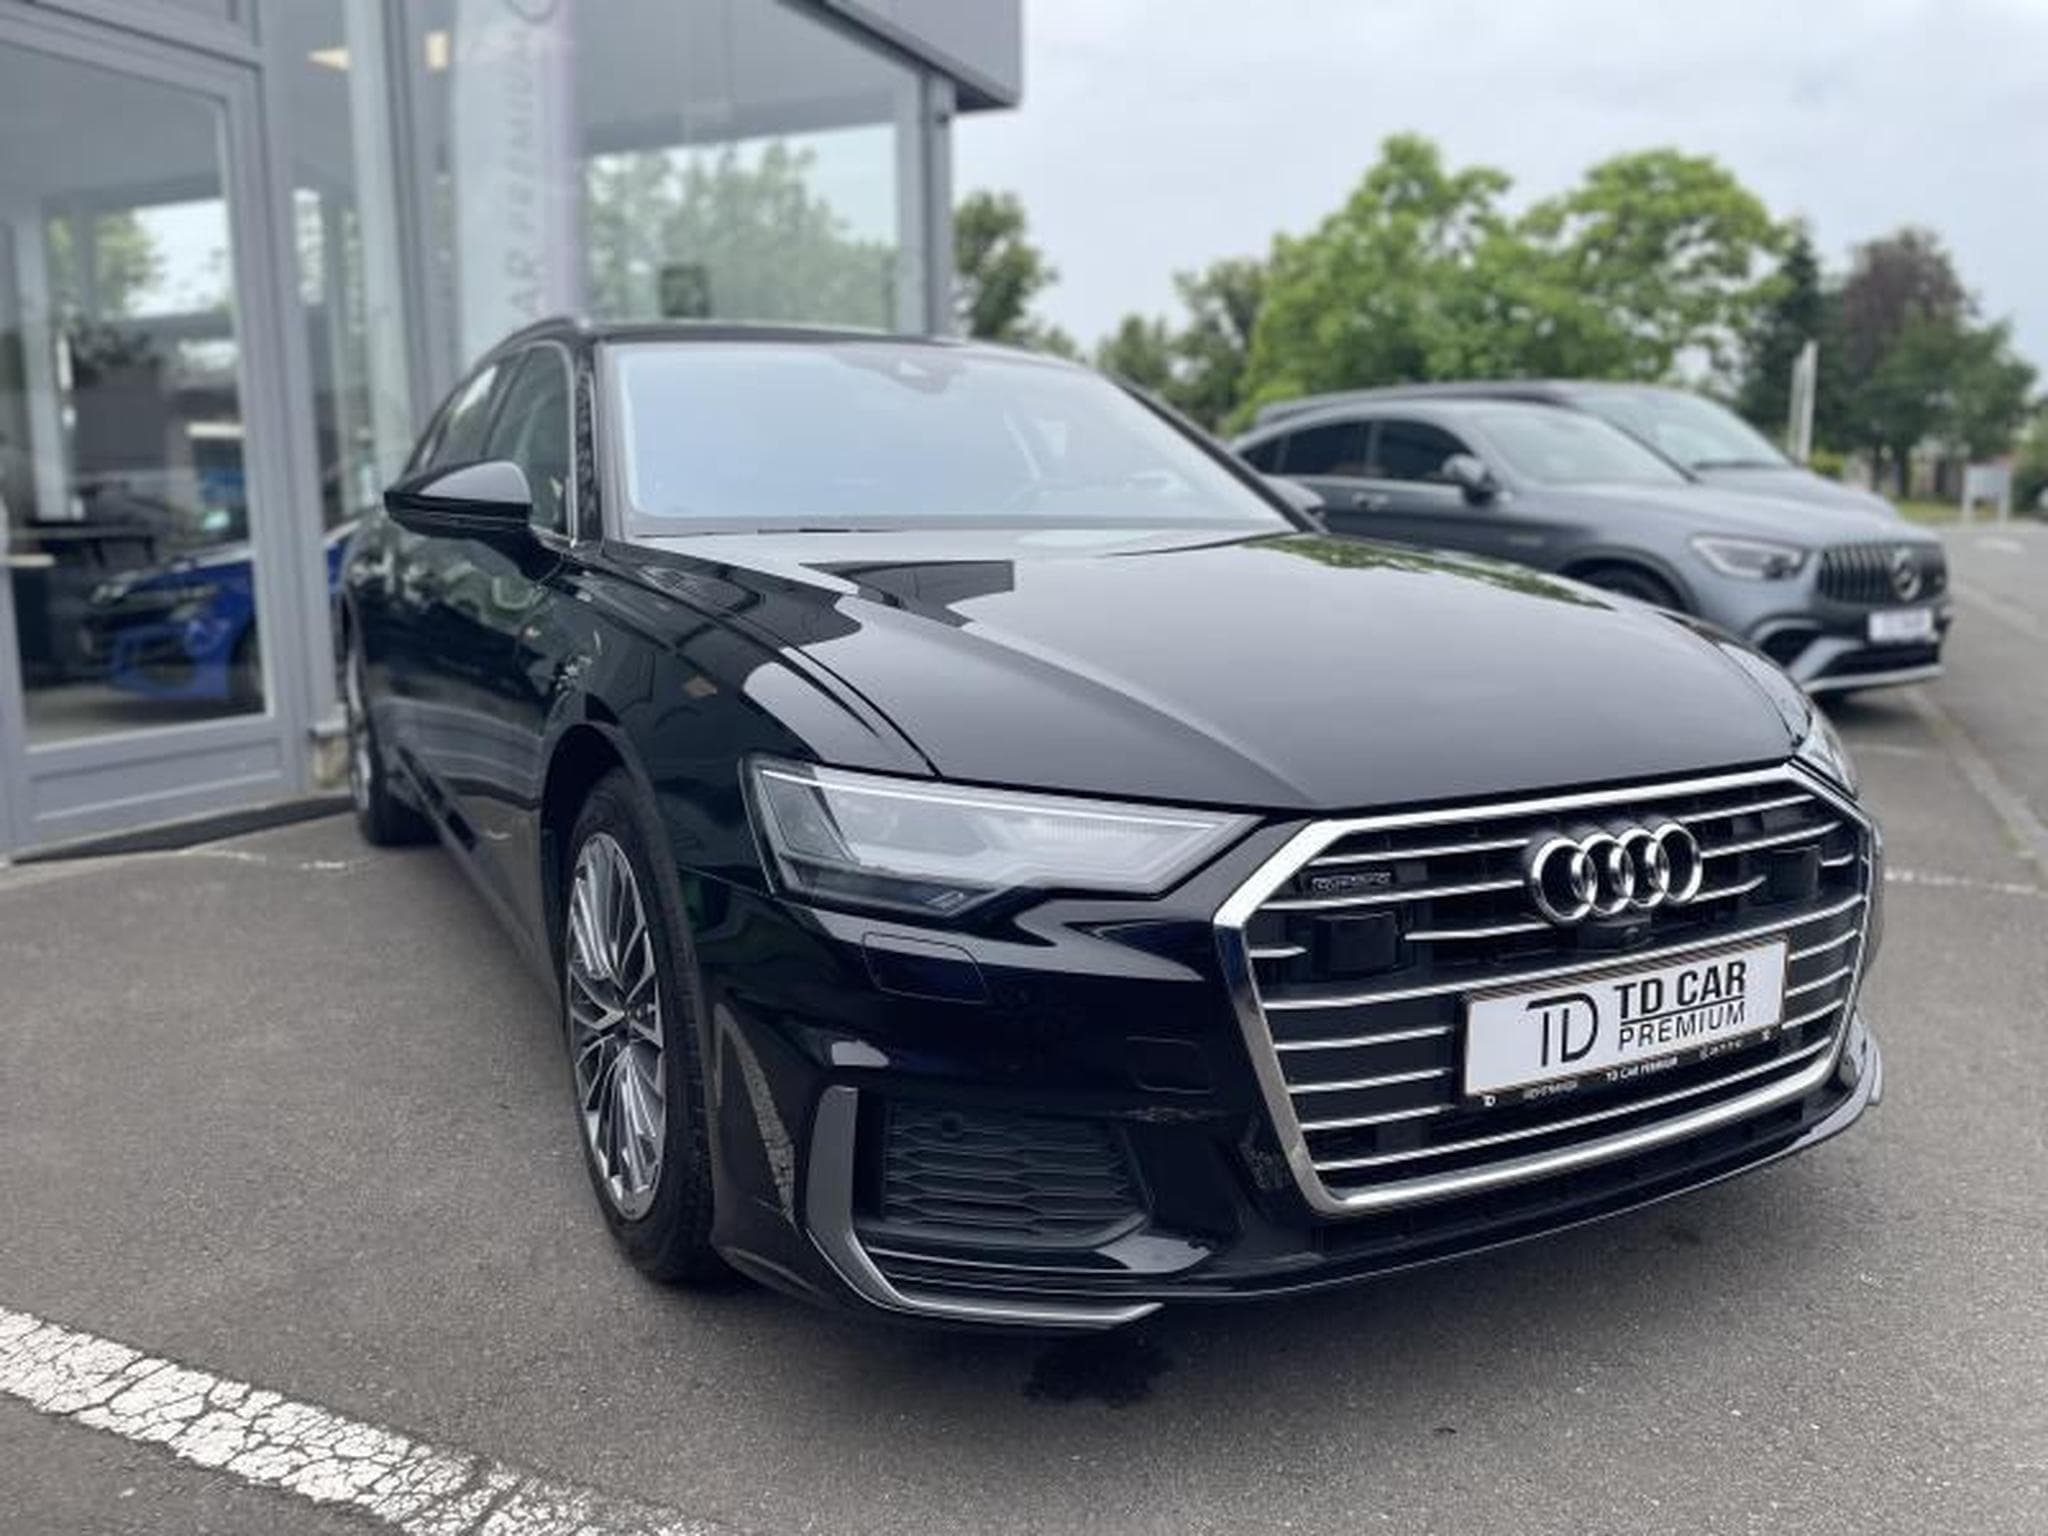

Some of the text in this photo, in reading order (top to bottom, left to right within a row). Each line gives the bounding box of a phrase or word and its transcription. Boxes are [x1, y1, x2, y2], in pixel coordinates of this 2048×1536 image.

[1613, 960, 1747, 1019] TD CAR
[1618, 1001, 1746, 1050] PREMIUM
